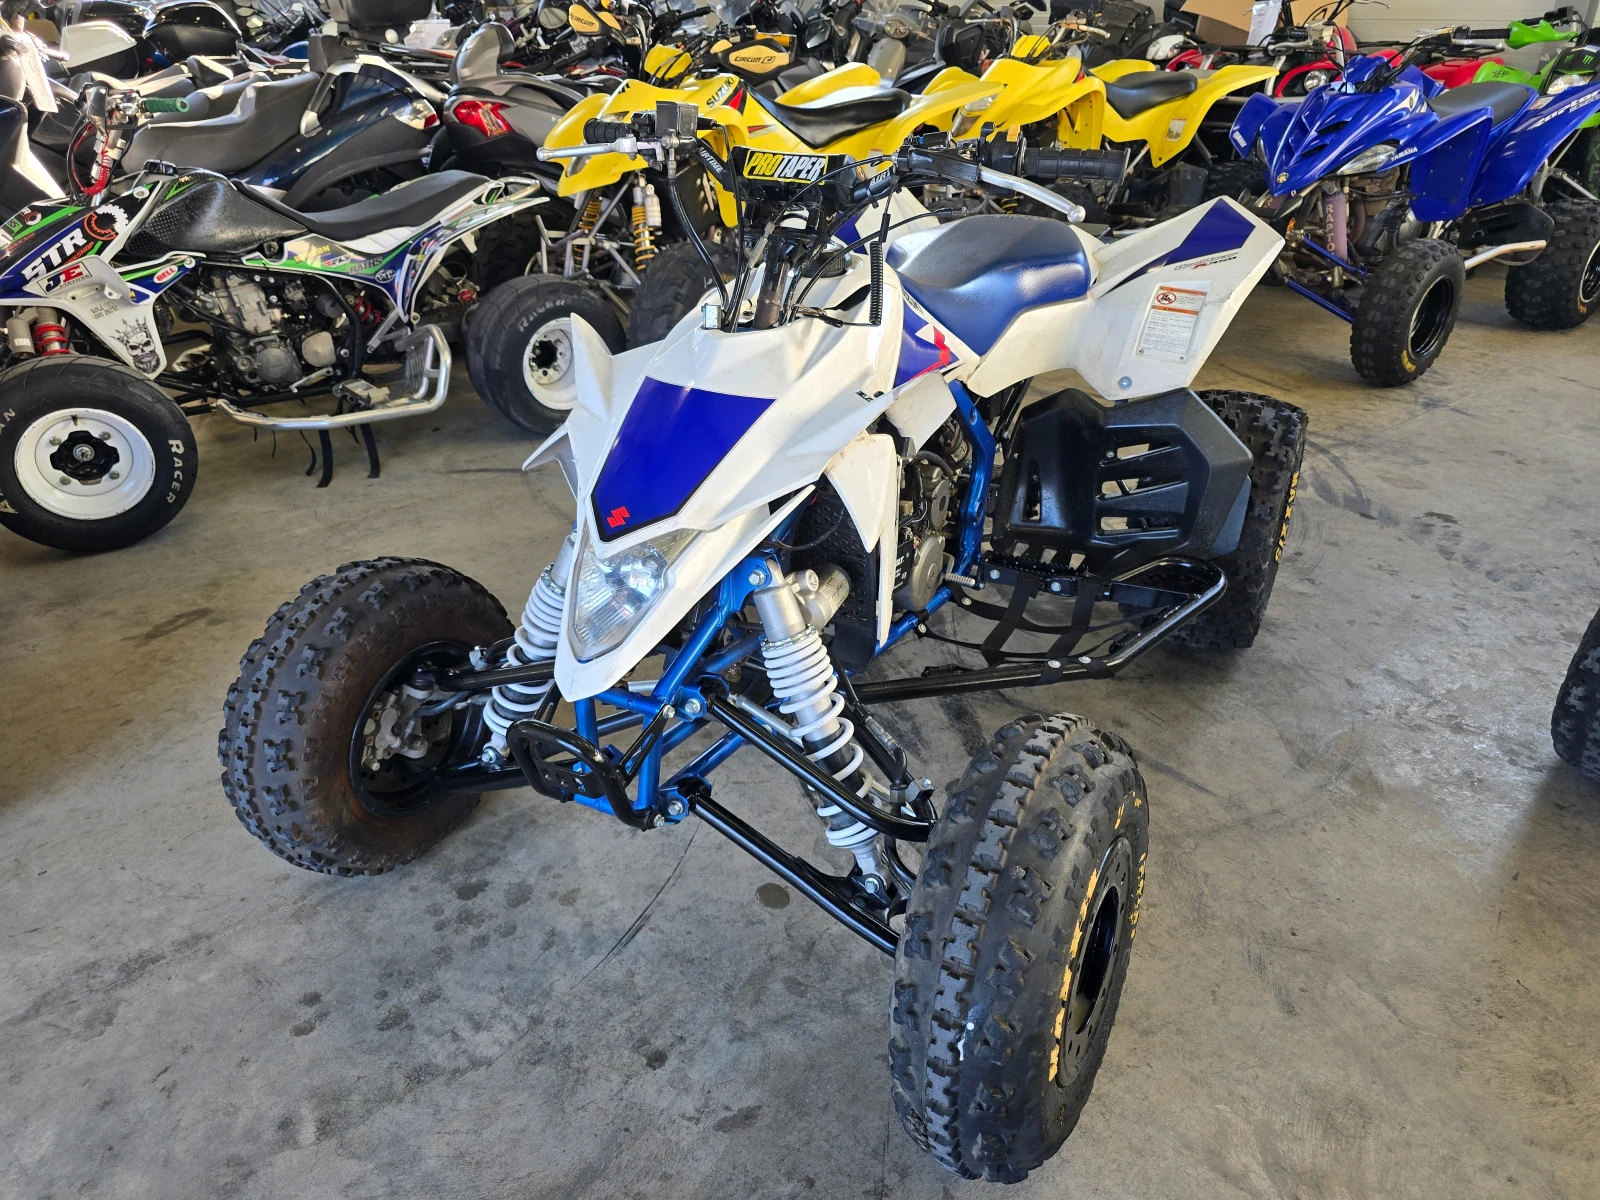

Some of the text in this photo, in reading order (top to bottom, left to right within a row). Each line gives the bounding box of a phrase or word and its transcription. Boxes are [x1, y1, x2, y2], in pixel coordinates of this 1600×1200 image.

[706, 77, 735, 109] SUZUKI
[748, 152, 826, 182] PROTAPER
[1391, 146, 1418, 162] YAMAHA
[1325, 203, 1335, 256] RAPTO
[21, 227, 88, 281] STR
[45, 264, 84, 293] JE
[156, 267, 176, 282] BELL
[168, 439, 185, 504] RACER
[1274, 471, 1300, 564] MAXXIS
